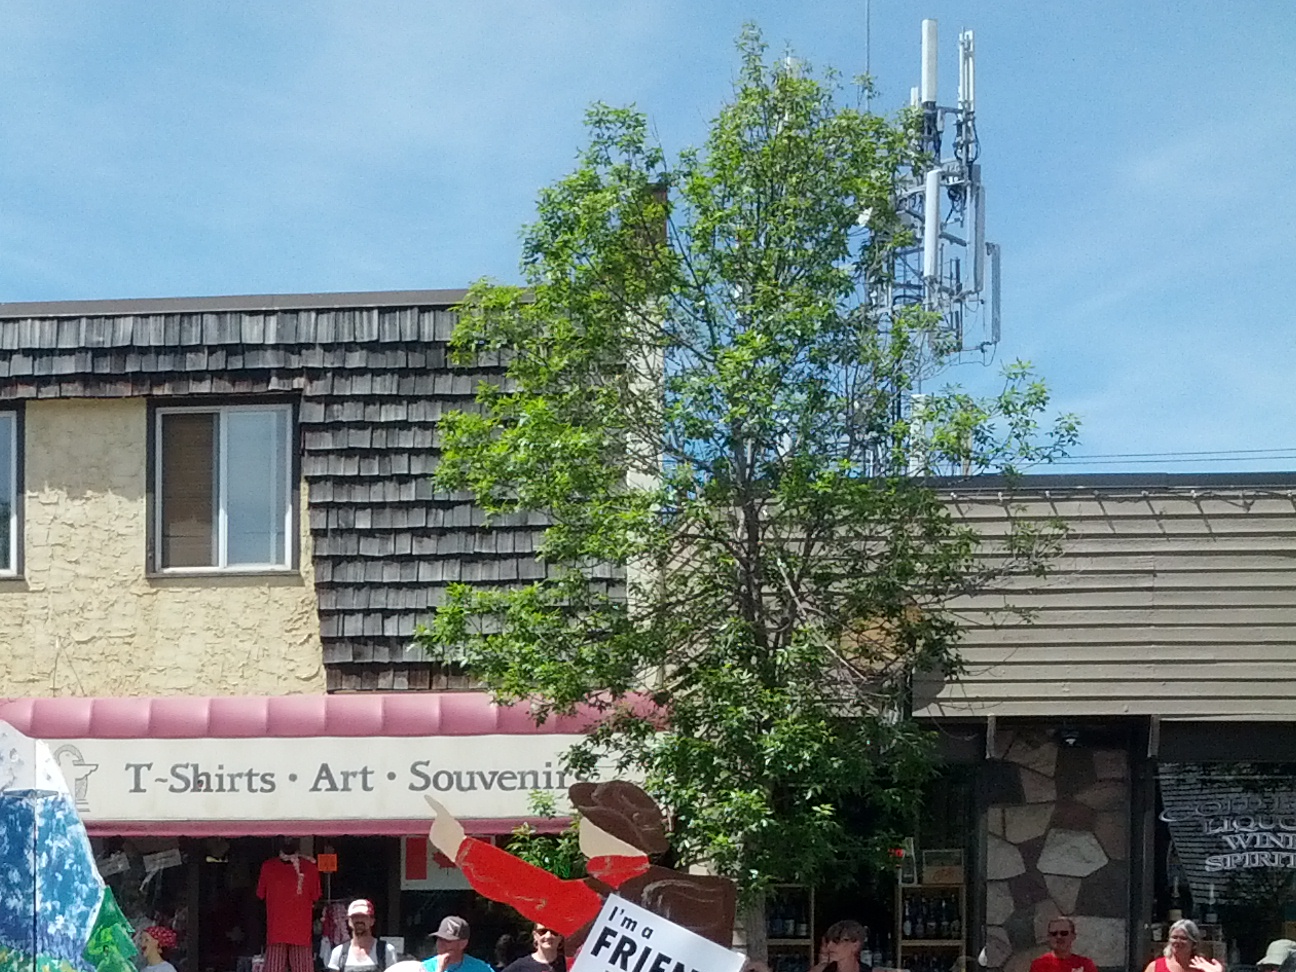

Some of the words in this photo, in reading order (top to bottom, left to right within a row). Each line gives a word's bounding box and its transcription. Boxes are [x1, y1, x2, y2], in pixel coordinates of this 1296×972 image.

[309, 762, 374, 792] Art
[608, 906, 637, 932] I'm
[641, 928, 654, 940] a
